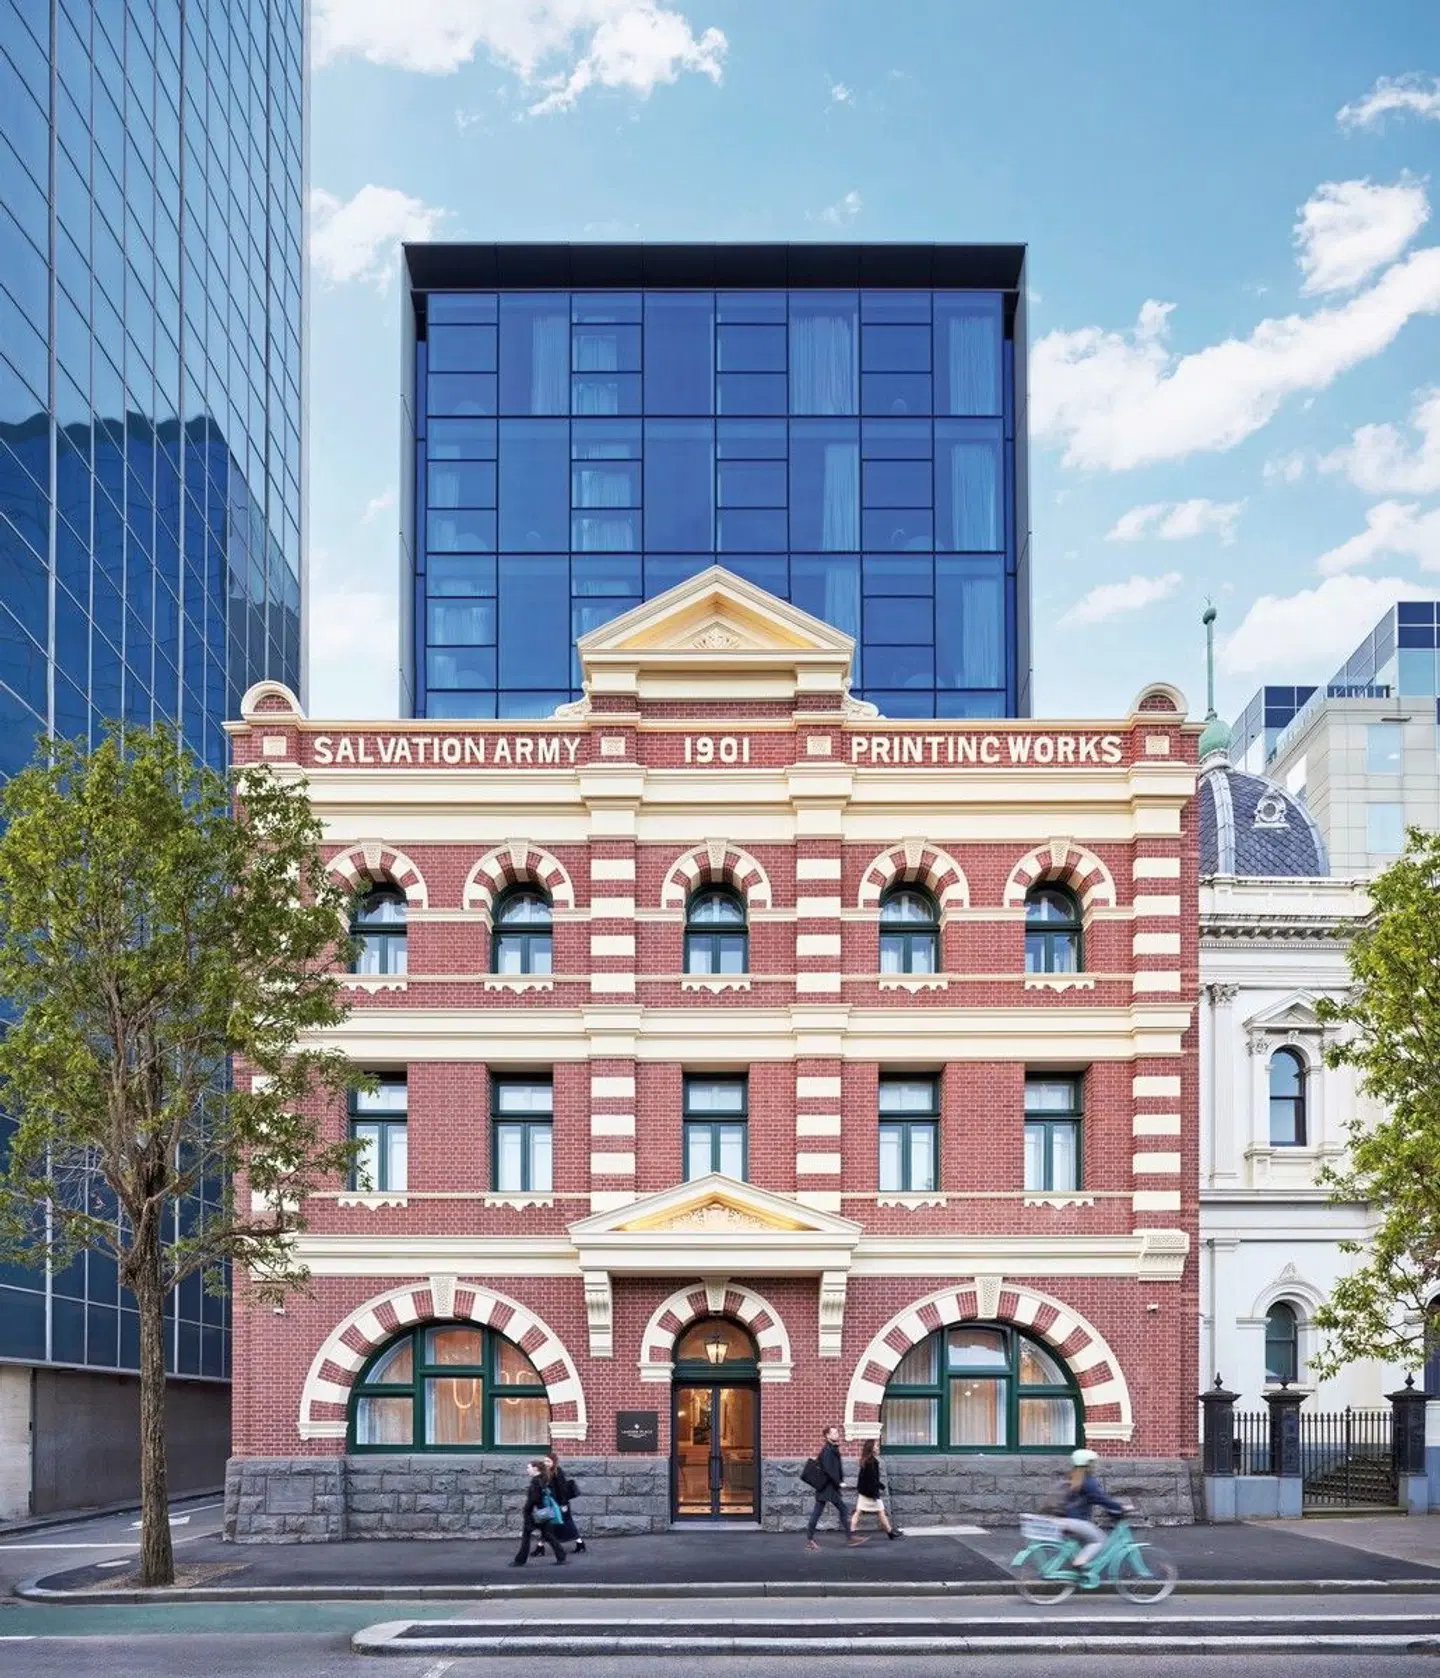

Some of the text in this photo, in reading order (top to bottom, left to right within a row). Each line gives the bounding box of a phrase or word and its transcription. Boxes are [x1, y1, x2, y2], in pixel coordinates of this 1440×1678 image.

[313, 736, 581, 764] SALVATION ARMY
[684, 736, 751, 763] 1901
[1007, 735, 1123, 764] WORKS
